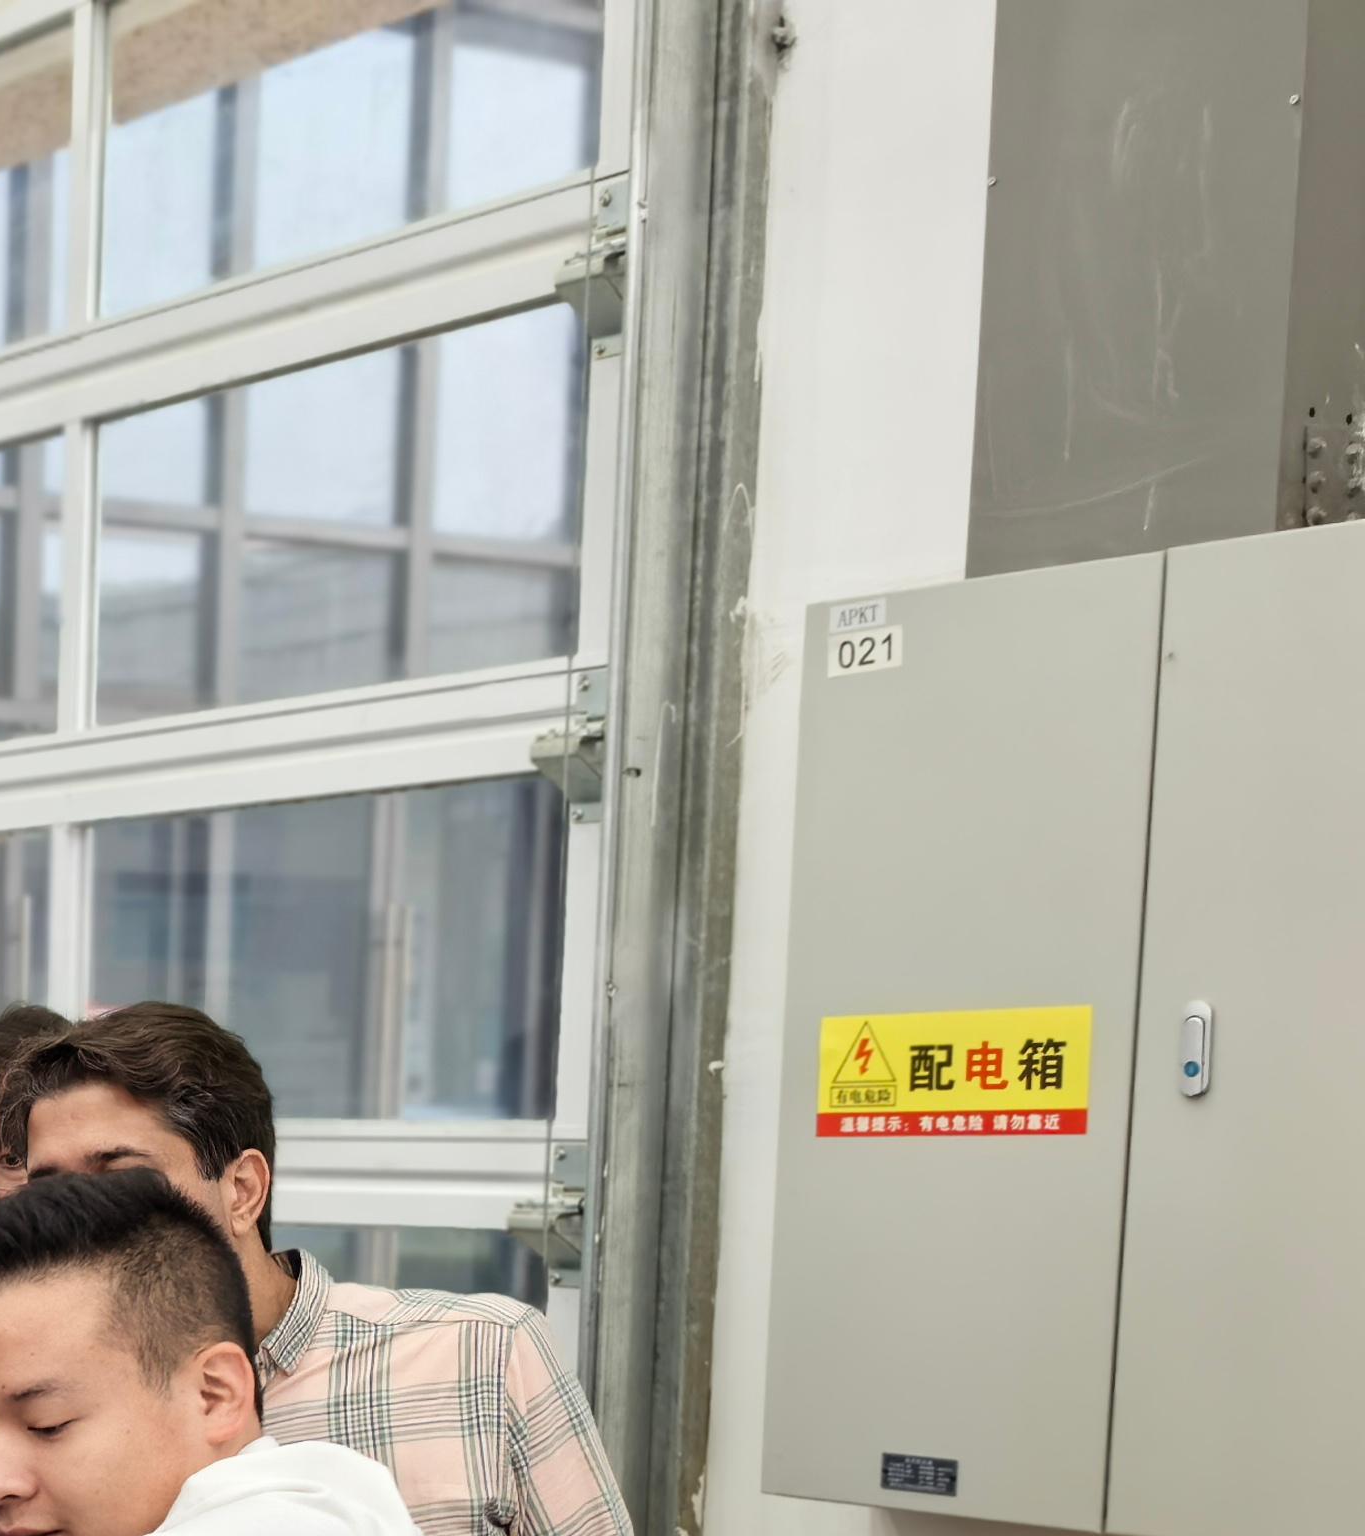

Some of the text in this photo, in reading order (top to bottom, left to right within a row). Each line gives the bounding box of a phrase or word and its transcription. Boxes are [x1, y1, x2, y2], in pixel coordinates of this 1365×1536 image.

[837, 604, 879, 628] APKT
[838, 633, 892, 669] 021
[908, 1038, 1067, 1091] 配电箱
[919, 1114, 984, 1131] 有电危险
[993, 1113, 1061, 1131] 请勿靠近
